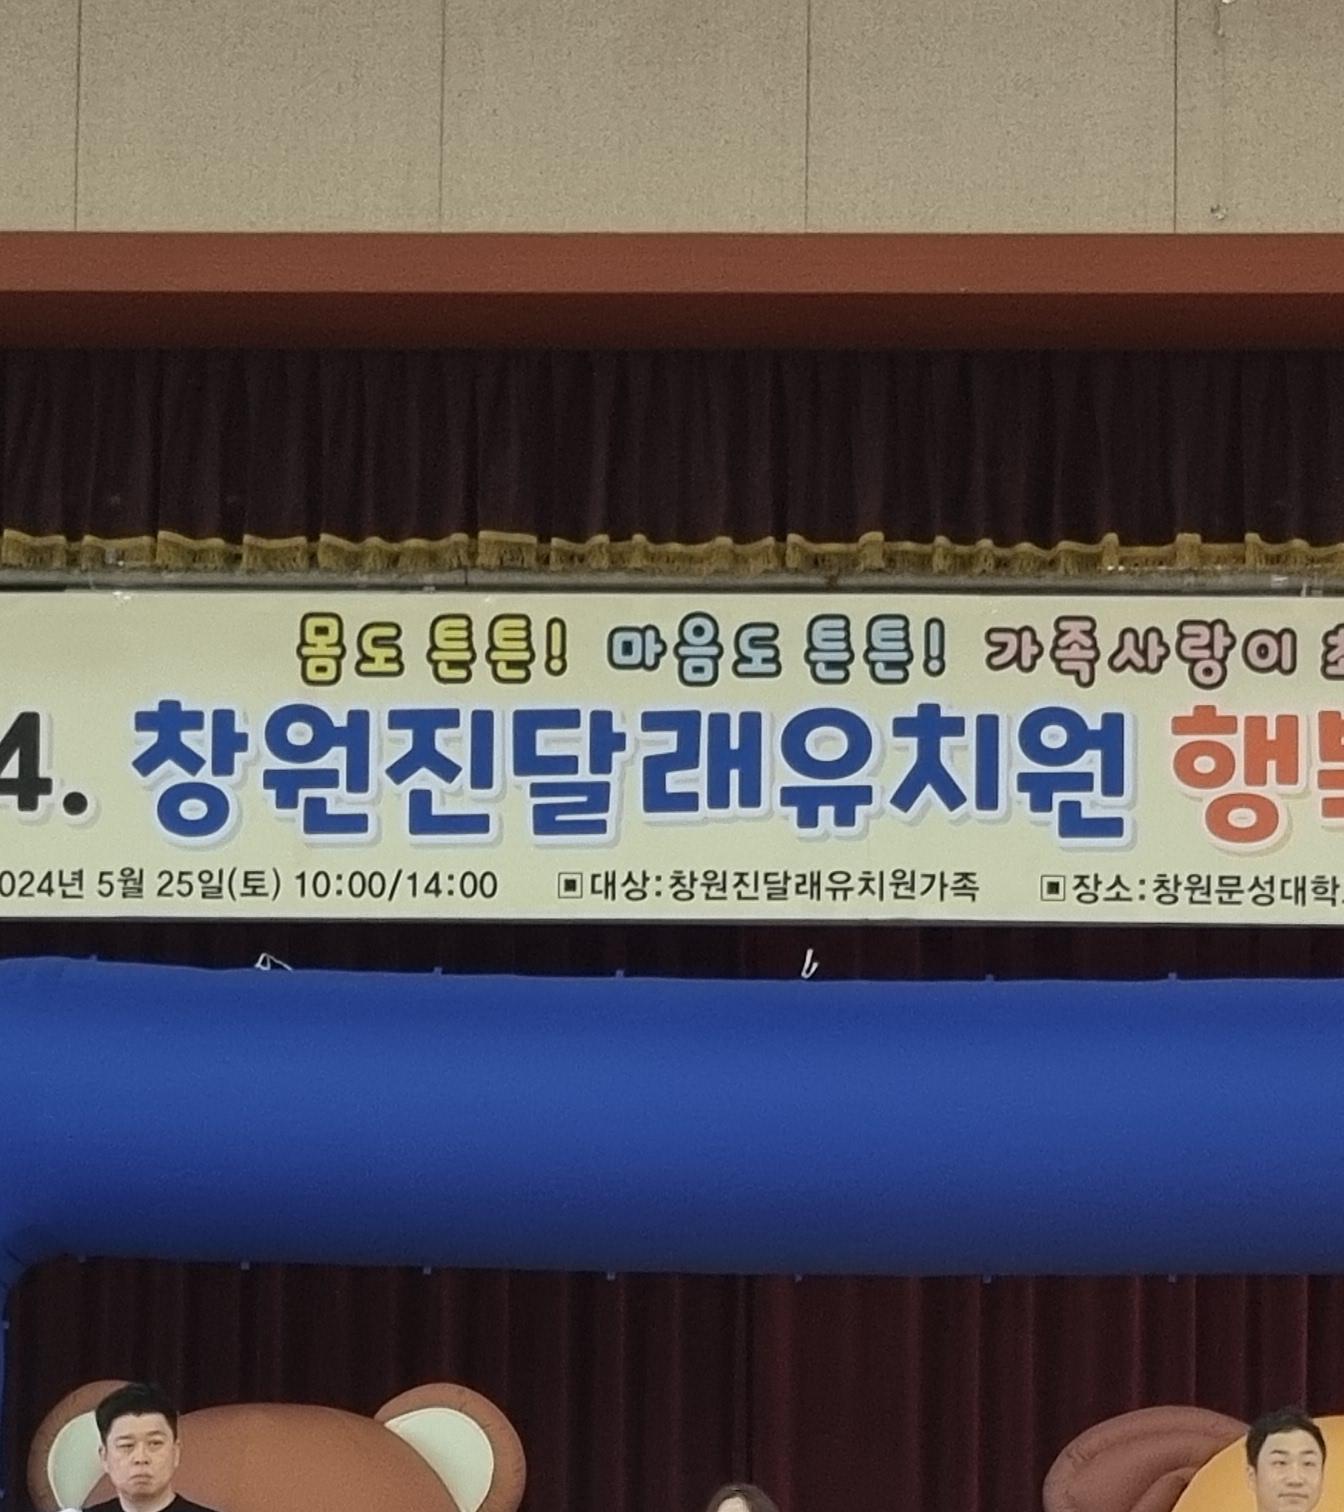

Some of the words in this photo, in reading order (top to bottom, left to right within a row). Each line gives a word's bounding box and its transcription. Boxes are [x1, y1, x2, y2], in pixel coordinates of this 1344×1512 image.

[297, 612, 404, 686] 몸도
[426, 613, 568, 685] 튼튼!
[607, 613, 782, 687] 마음도
[804, 614, 948, 686] 튼튼!
[985, 614, 1297, 689] 가족사랑이
[131, 700, 1130, 841] 창원진달래유치원
[96, 868, 148, 901] 5월
[156, 867, 283, 902] 25일(토)
[293, 870, 499, 901] 10:00/14:00
[590, 868, 980, 905] 대상:창원진달래유치원가족
